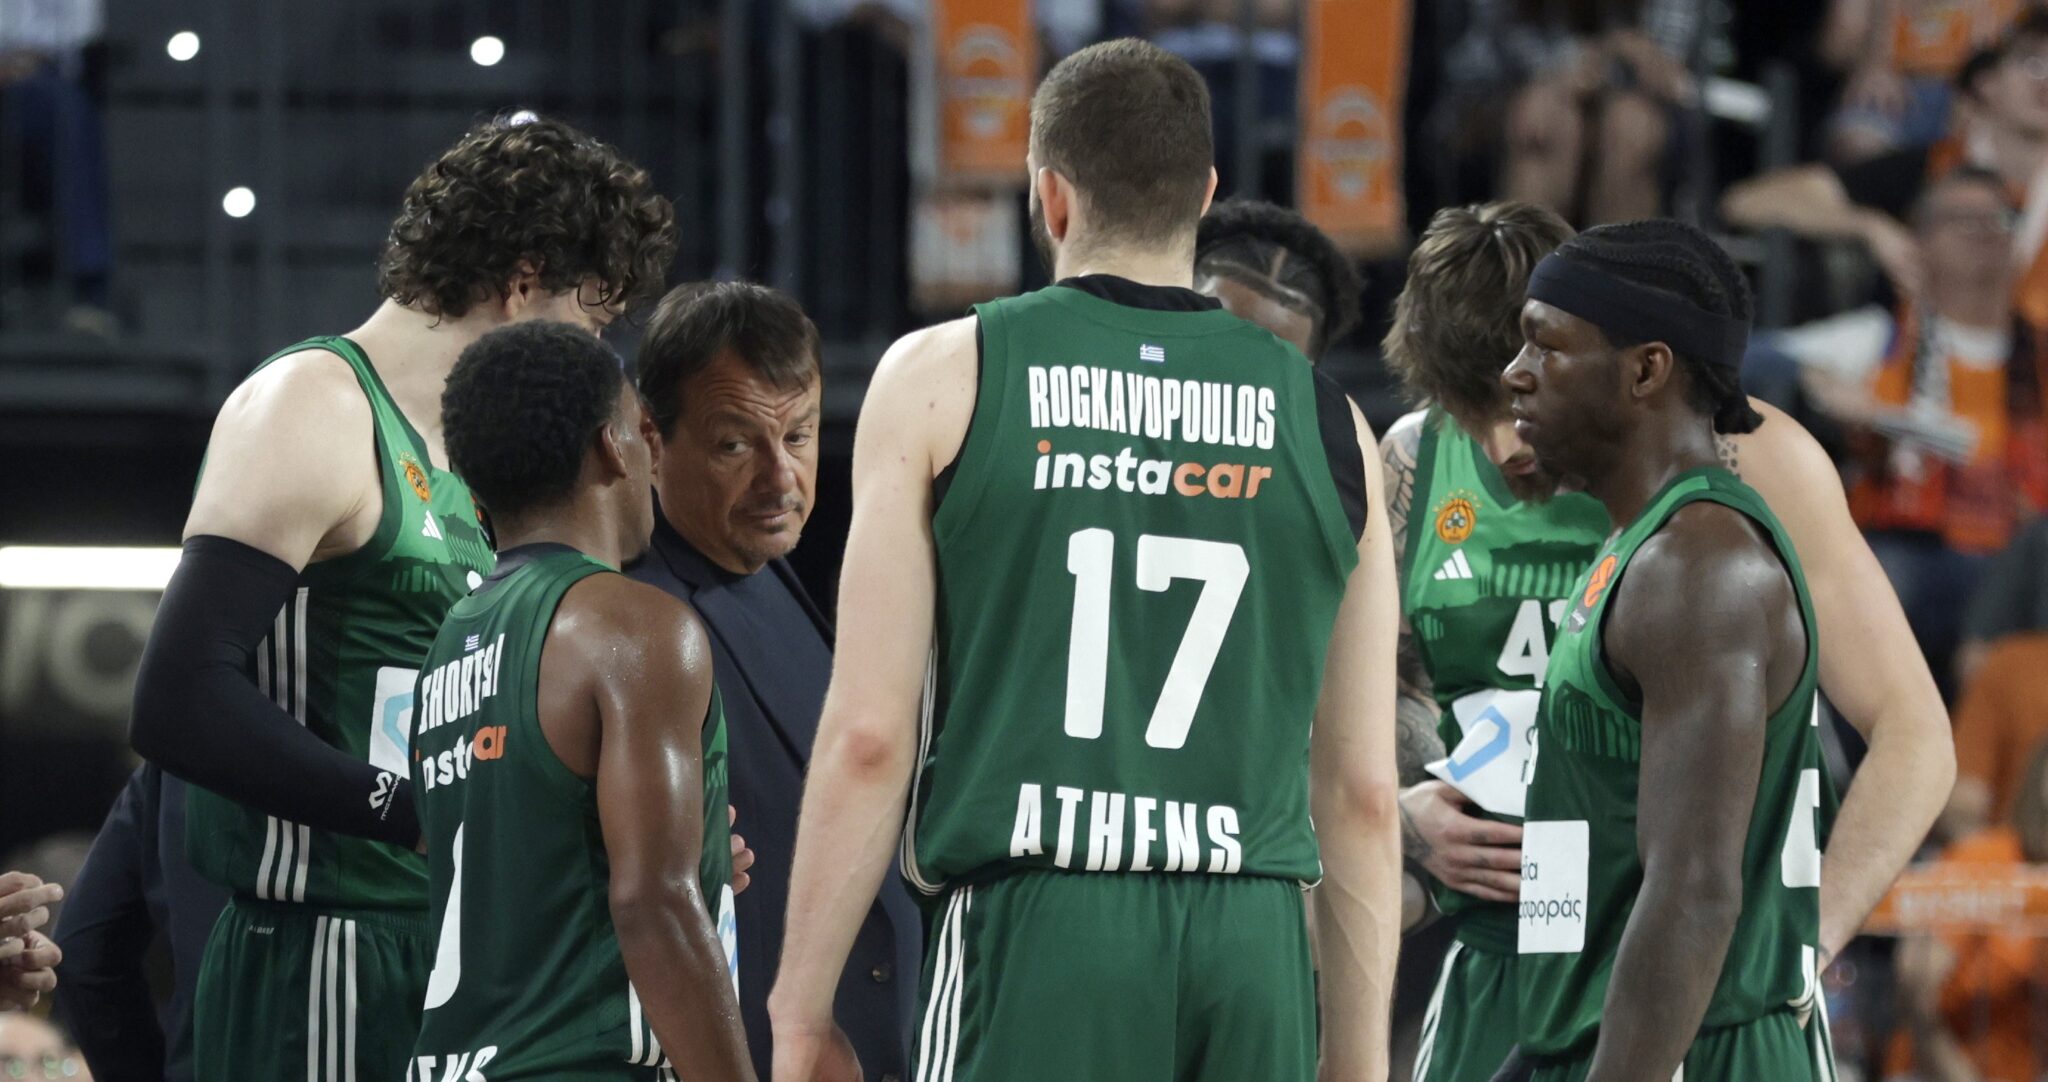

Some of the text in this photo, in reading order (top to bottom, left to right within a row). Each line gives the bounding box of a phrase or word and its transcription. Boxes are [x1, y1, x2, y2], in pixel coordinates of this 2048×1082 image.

[1028, 366, 1276, 449] ROGKAVOPOULOS
[1033, 439, 1272, 499] instacar
[1064, 527, 1250, 749] 17
[1009, 783, 1242, 874] ATHENS
